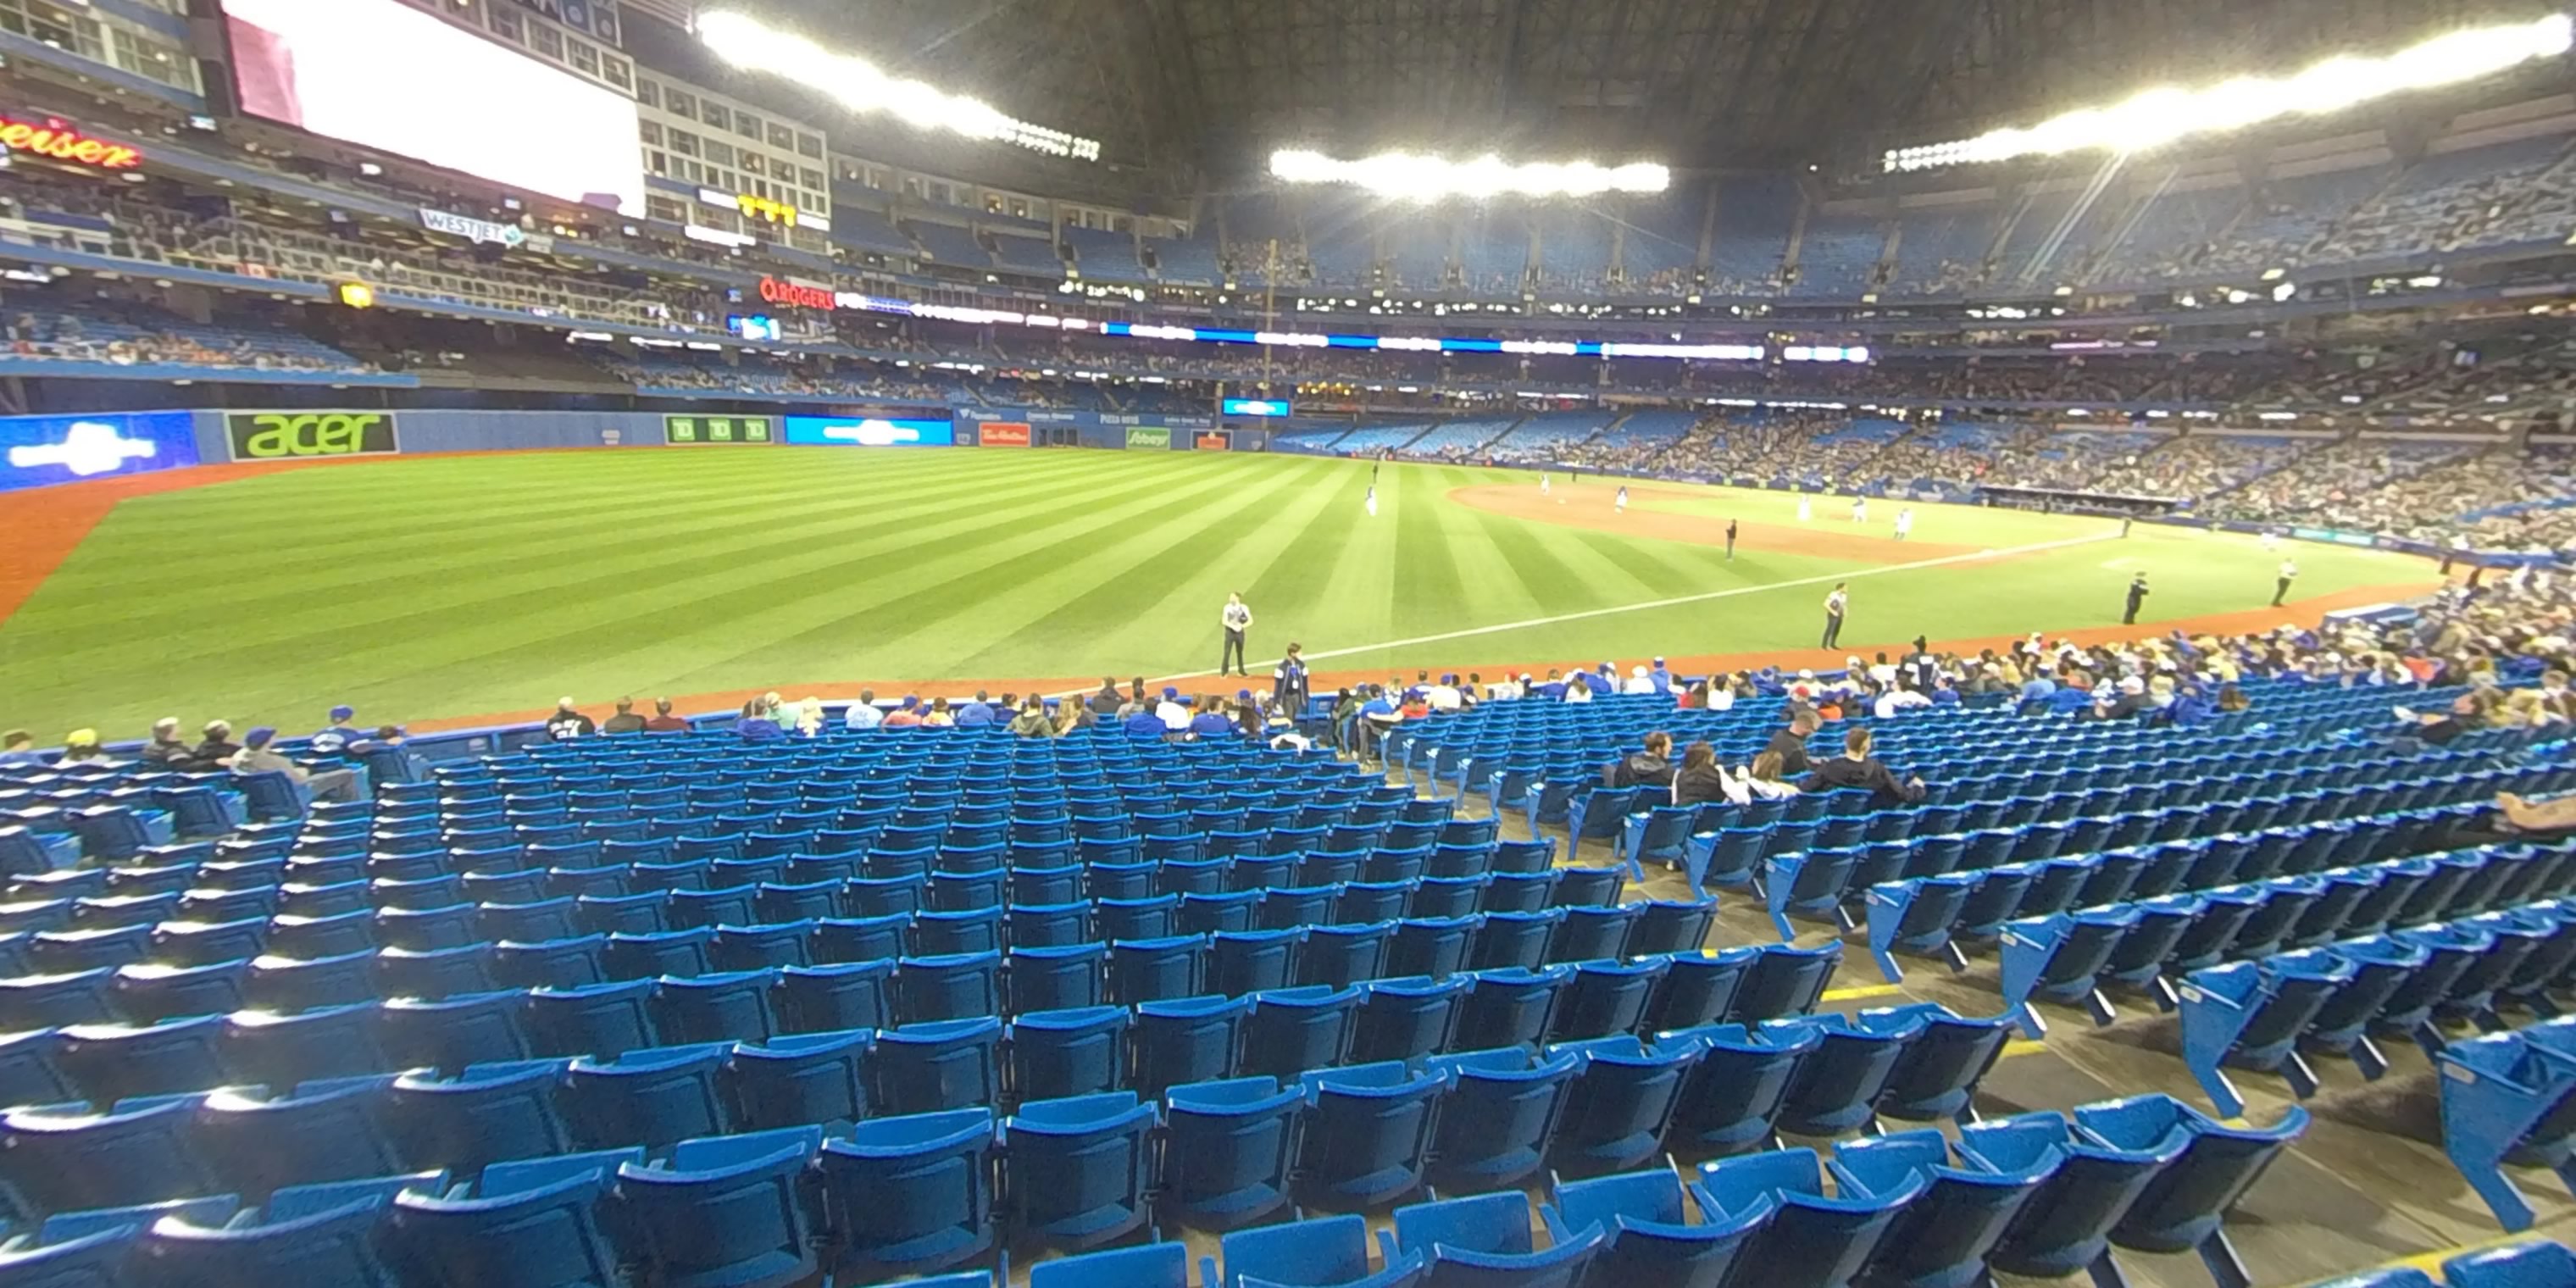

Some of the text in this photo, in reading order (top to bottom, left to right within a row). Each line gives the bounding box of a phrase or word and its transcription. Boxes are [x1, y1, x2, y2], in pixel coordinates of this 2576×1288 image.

[0, 119, 137, 167] eiser
[426, 211, 502, 240] WESTJET
[778, 282, 836, 311] ROGERS
[247, 414, 380, 458] acer
